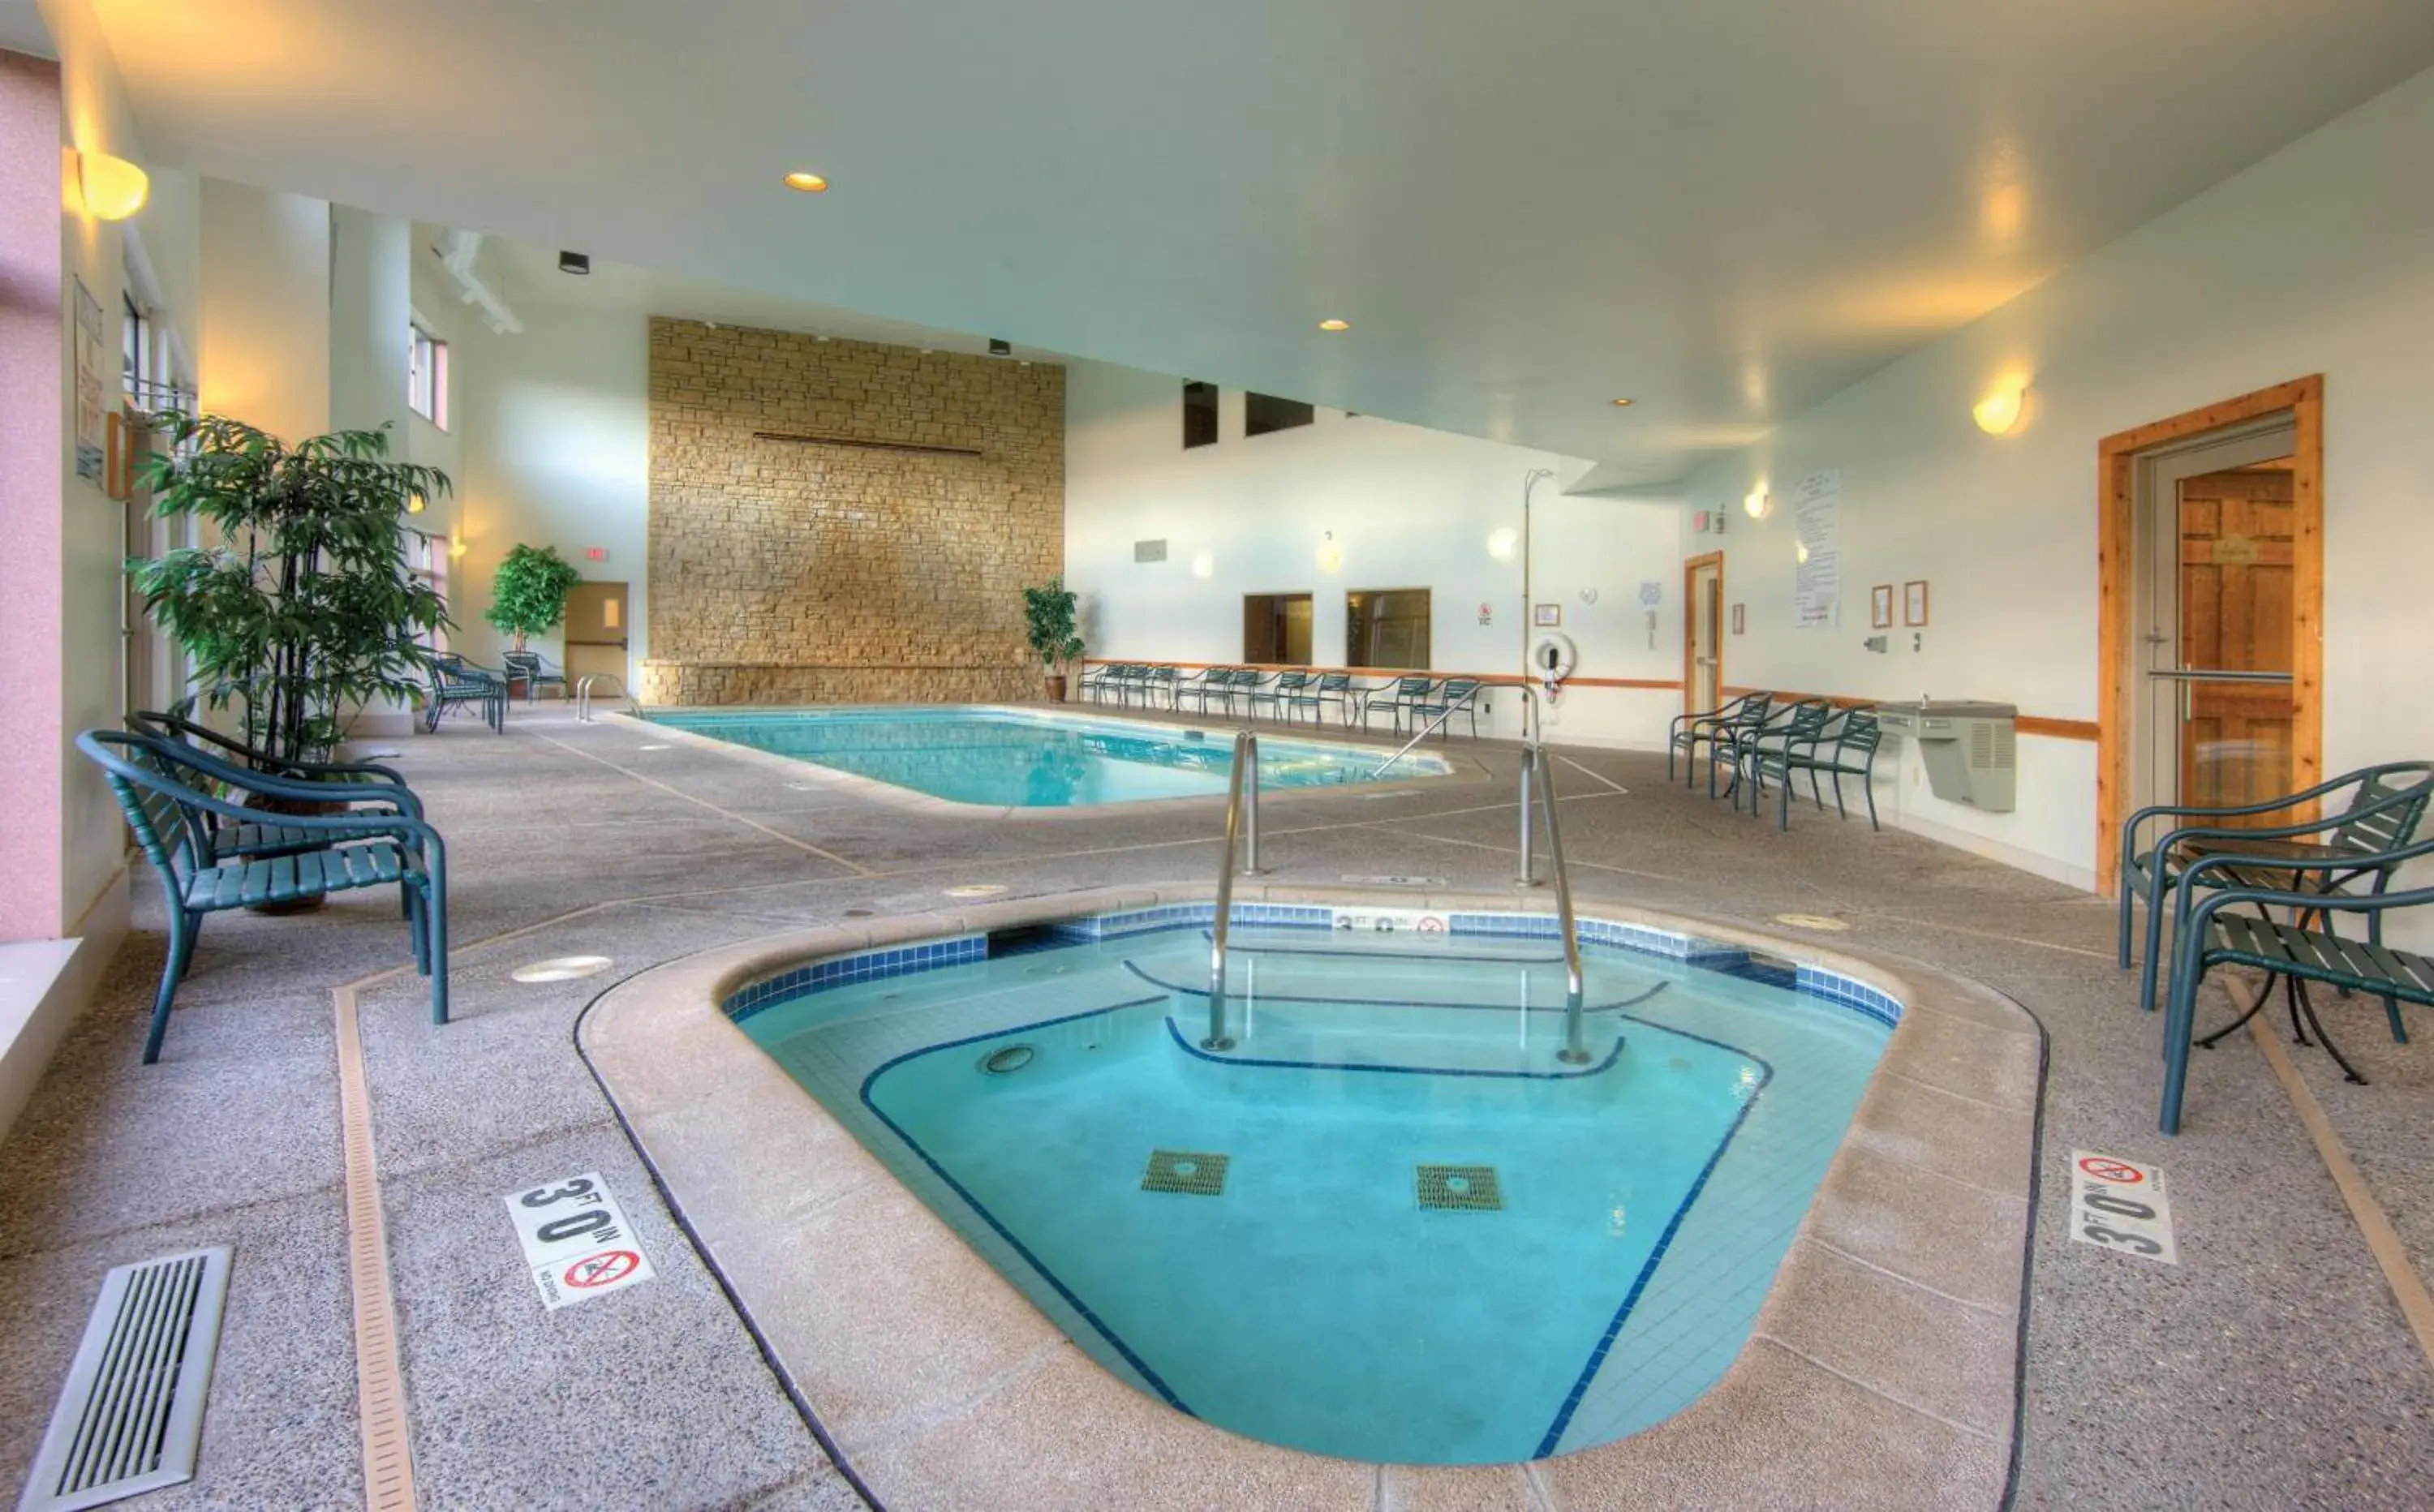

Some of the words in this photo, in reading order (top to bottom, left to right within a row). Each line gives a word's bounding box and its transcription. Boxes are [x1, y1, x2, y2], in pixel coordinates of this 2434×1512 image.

[521, 1179, 595, 1208] 3
[574, 1192, 603, 1207] FT
[2084, 1193, 2157, 1221] 0
[536, 1209, 612, 1244] 0
[592, 1225, 623, 1244] IN
[2083, 1225, 2163, 1255] 3
